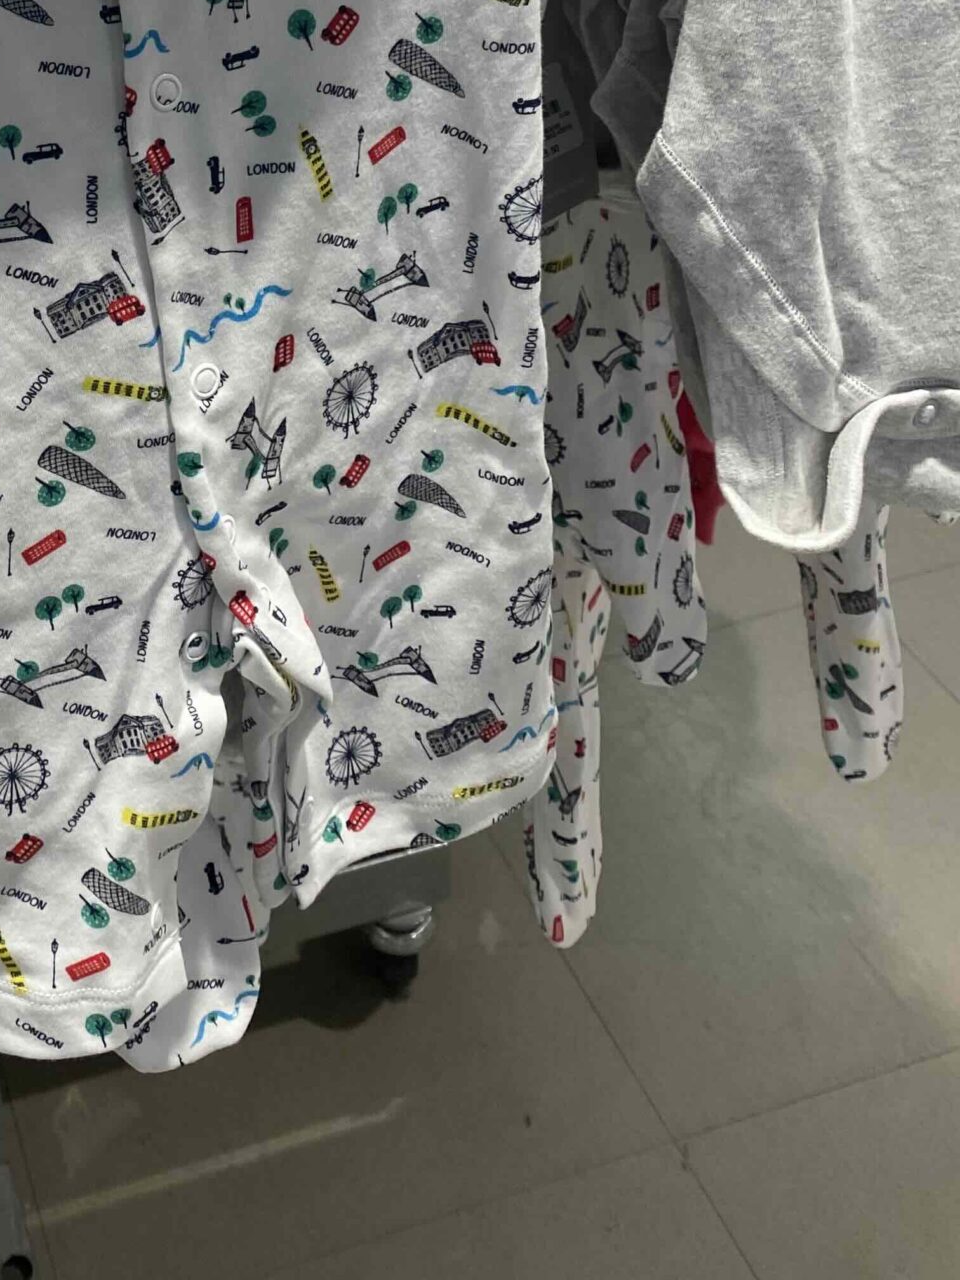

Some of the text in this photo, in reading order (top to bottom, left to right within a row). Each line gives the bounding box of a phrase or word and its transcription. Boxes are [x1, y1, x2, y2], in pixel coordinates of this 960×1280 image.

[481, 40, 536, 55] LONDON
[37, 61, 91, 79] LONDON
[316, 81, 359, 100] LONDON
[441, 123, 489, 155] LONDON
[246, 162, 296, 176] LONDON
[86, 175, 99, 224] LONDON
[316, 232, 358, 250] LONDON
[462, 232, 480, 274] LONDON
[5, 265, 59, 289] LONDON
[391, 312, 431, 329] LONDON
[306, 327, 335, 367] LONDON
[521, 327, 539, 368] LONDON
[15, 367, 55, 413] LONDON
[385, 402, 418, 446] LONDON
[137, 432, 176, 449] LONDO
[477, 468, 525, 488] LONDON
[106, 527, 157, 542] LONDON
[445, 541, 492, 568] LONDON
[136, 620, 151, 663] LONDON
[317, 624, 360, 639] LONDON
[469, 639, 486, 675] LONDON
[62, 701, 109, 722] LONDON
[395, 694, 439, 720] LONDON
[393, 776, 430, 801] LONDON
[62, 791, 96, 834] LONDON
[0, 886, 48, 910] LONDON
[187, 979, 225, 990] ONDON
[15, 1017, 65, 1050] LONDON
